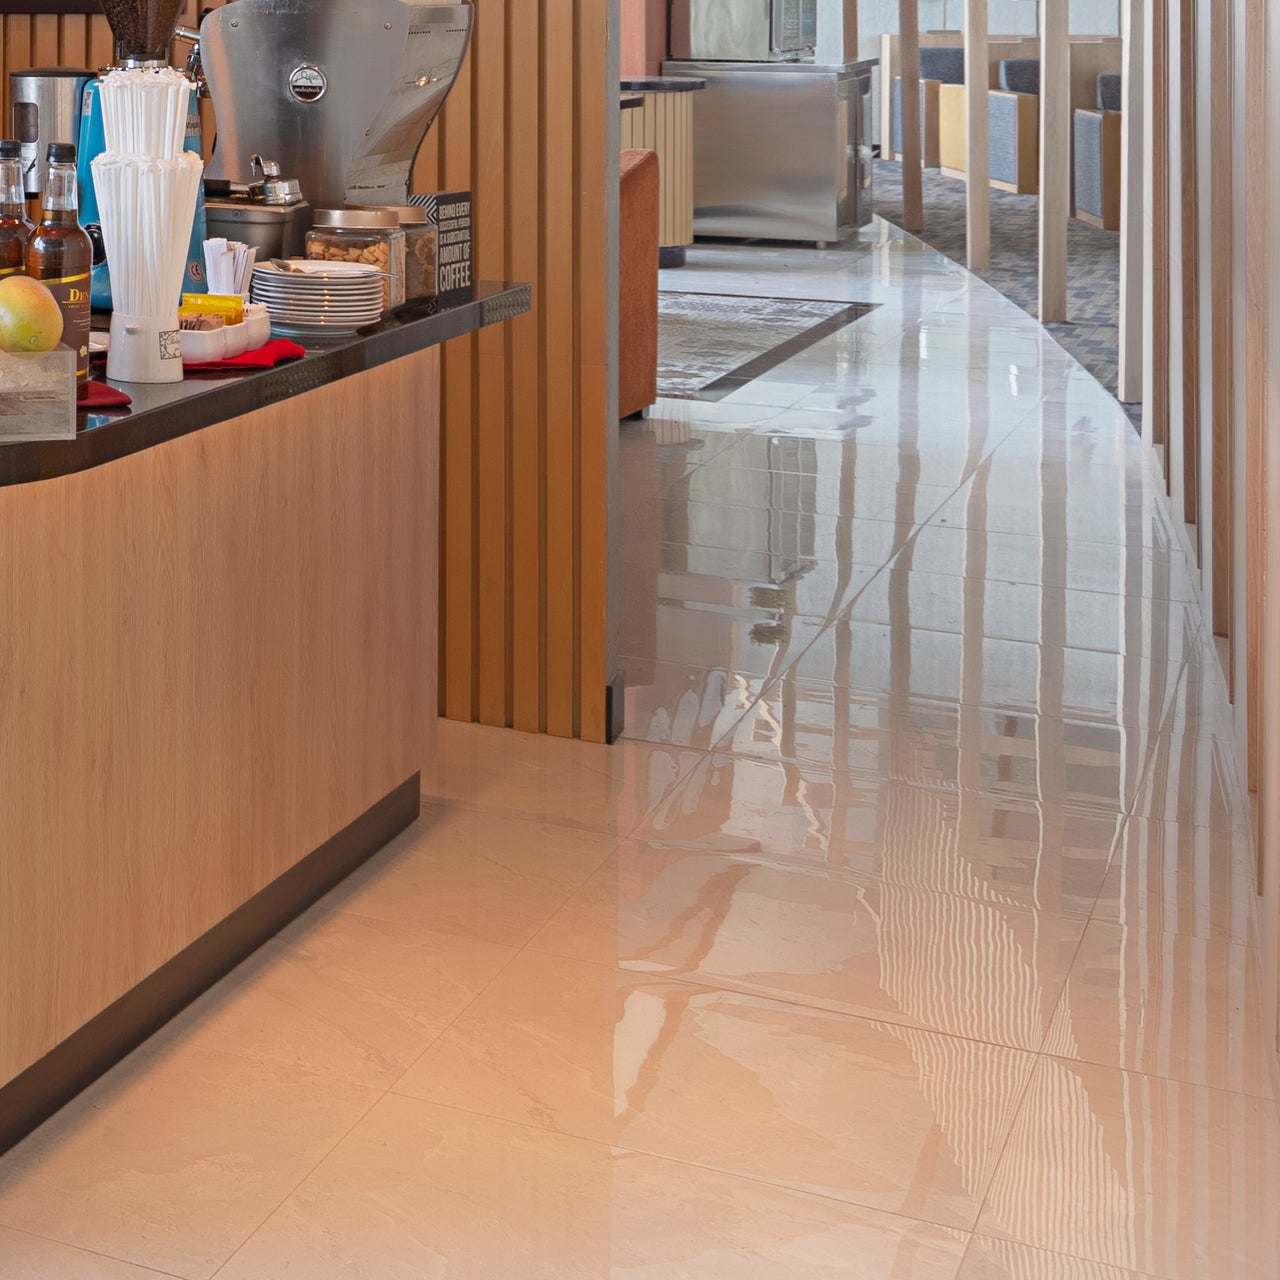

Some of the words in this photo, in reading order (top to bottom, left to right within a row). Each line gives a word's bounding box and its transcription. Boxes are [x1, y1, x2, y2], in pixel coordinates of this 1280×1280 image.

[439, 204, 456, 219] BEHIND
[456, 201, 470, 216] EVERY
[440, 244, 463, 264] AMOUNT
[463, 242, 471, 260] OF
[440, 261, 471, 292] COFFEE
